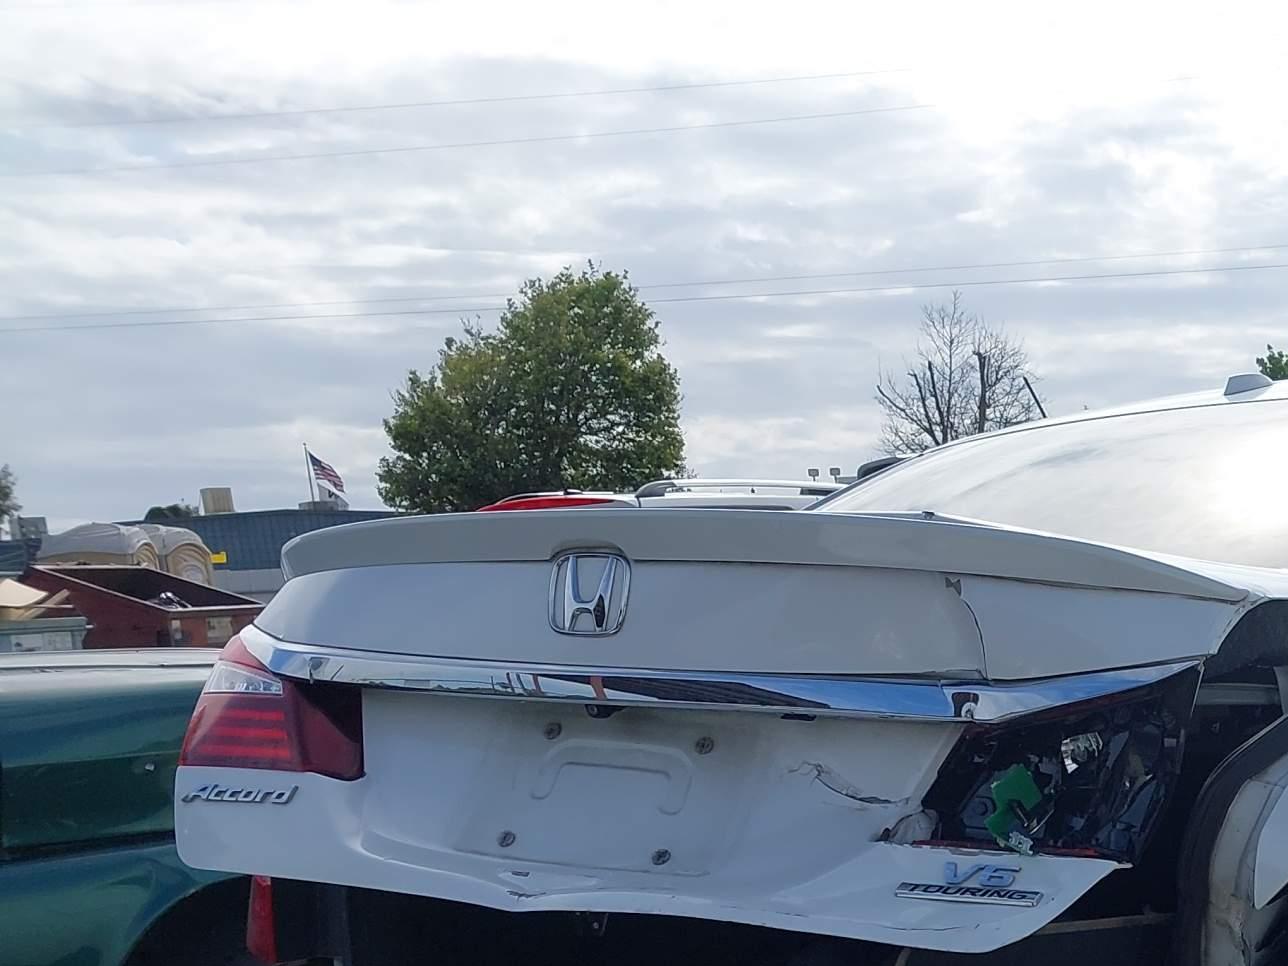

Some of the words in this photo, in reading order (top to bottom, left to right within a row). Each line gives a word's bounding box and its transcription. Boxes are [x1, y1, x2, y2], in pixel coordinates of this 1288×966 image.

[181, 784, 299, 804] Accord
[944, 861, 1021, 887] V6
[909, 883, 1031, 900] TOURING
